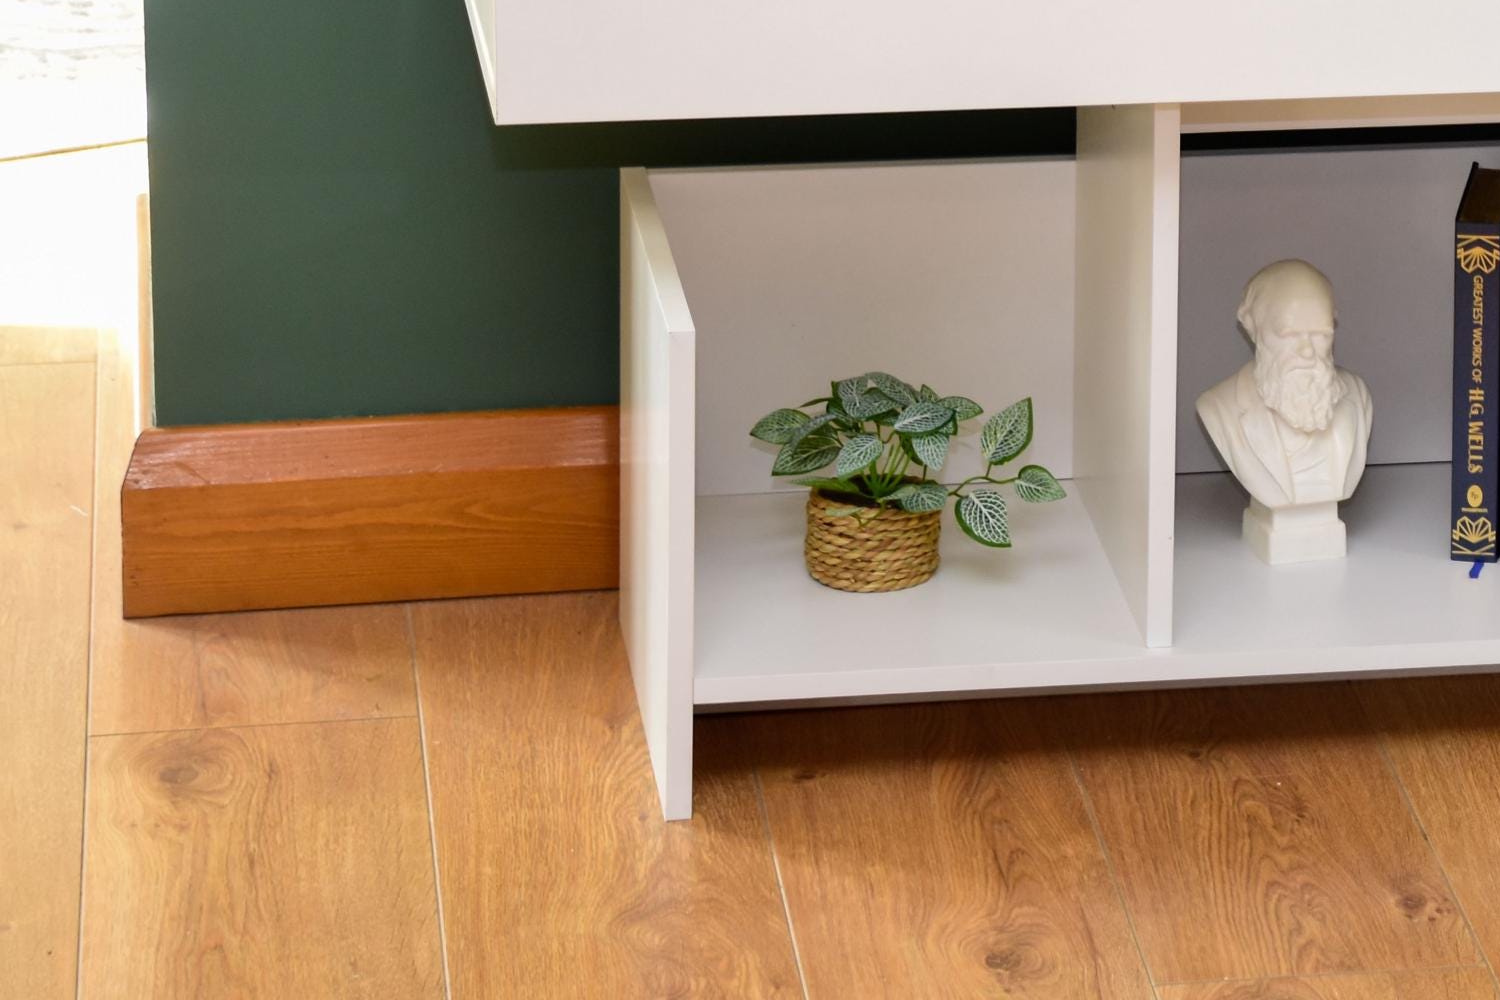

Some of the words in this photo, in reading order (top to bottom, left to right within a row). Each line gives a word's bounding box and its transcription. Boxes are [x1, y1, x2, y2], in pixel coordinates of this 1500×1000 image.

[1472, 275, 1484, 326] GREATEST
[1472, 327, 1483, 368] WORKS
[1472, 370, 1483, 384] OF
[1467, 421, 1484, 474] WELLS
